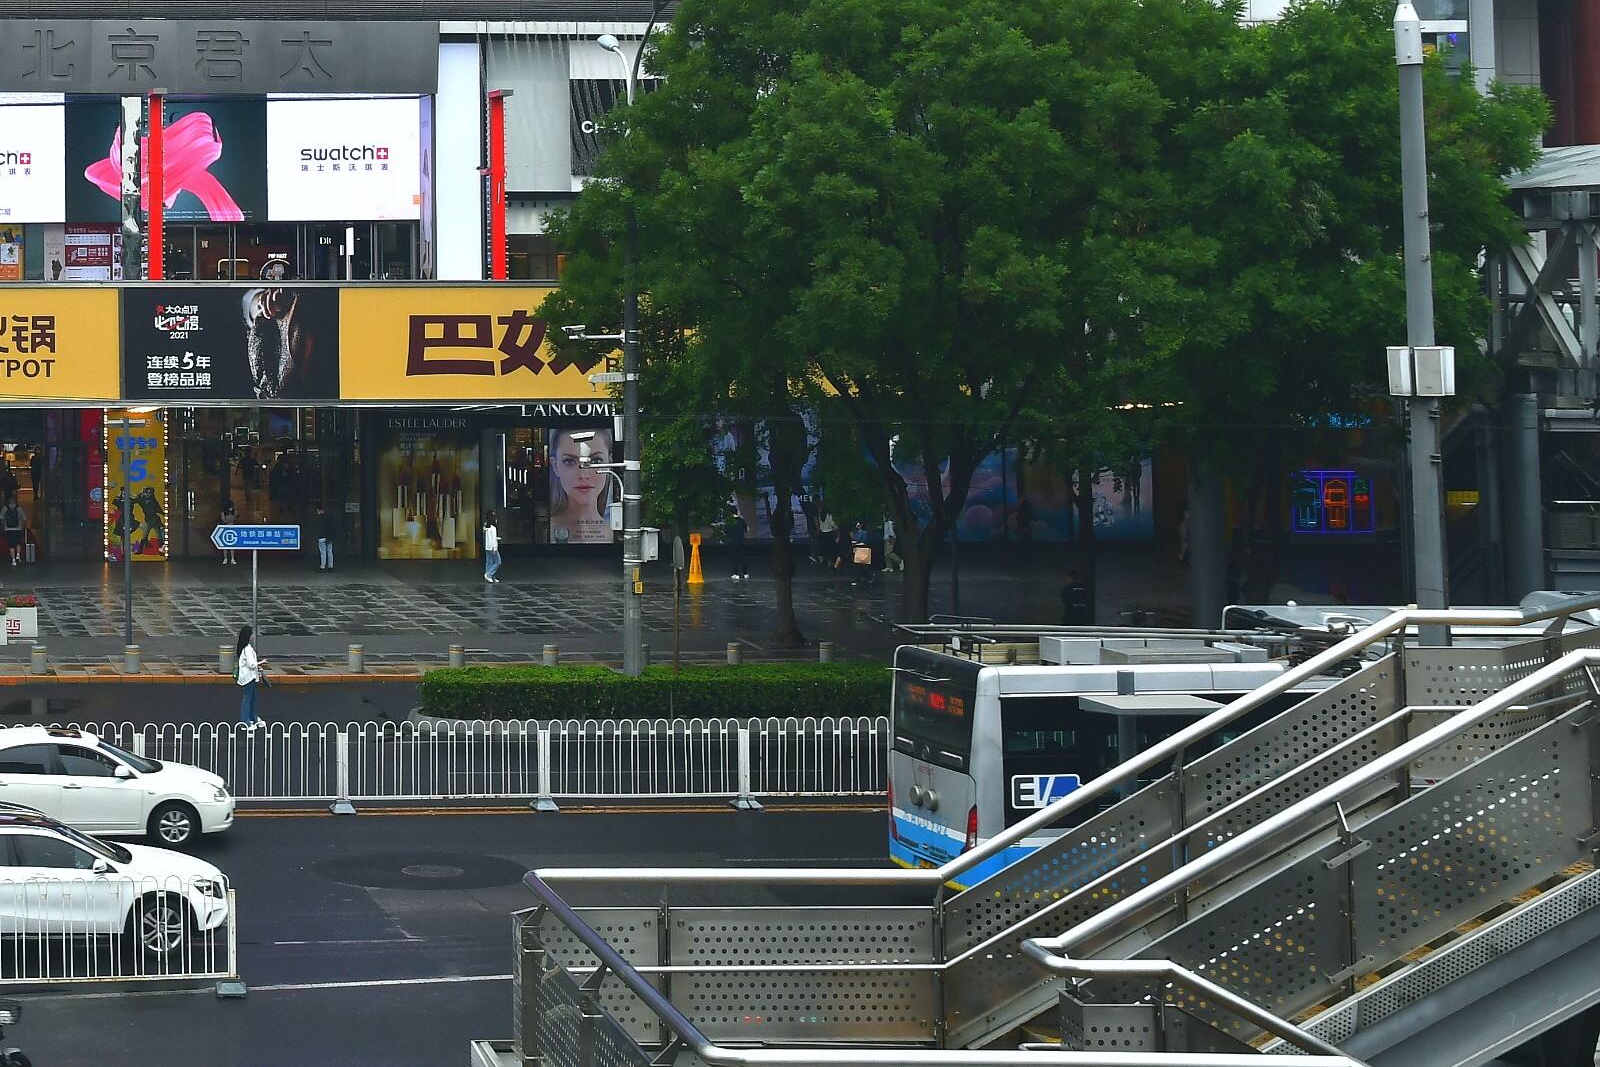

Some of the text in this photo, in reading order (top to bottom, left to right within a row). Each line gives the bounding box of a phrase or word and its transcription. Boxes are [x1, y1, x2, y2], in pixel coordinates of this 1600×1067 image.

[21, 27, 335, 83] 北京君太
[300, 145, 374, 161] swatch
[165, 305, 199, 314] 大众点评
[169, 332, 189, 340] 2021
[146, 351, 211, 370] 连续5年
[147, 372, 212, 387] 登榜品牌
[423, 418, 467, 428] LAUDER
[240, 530, 281, 538] 地铁西单站
[1013, 775, 1056, 809] EV
